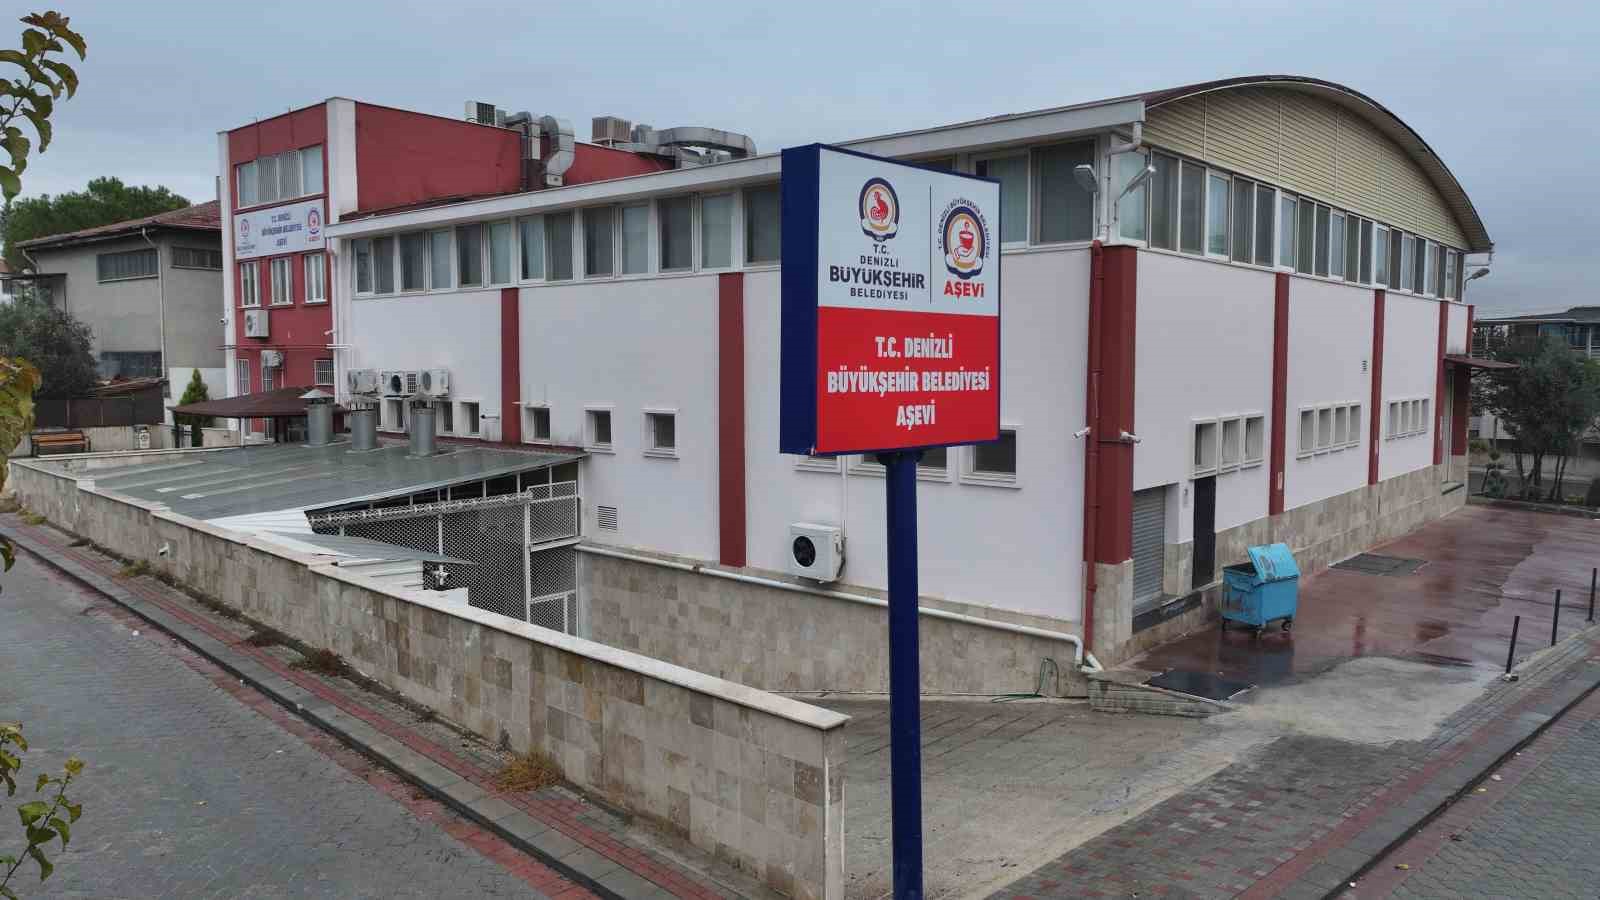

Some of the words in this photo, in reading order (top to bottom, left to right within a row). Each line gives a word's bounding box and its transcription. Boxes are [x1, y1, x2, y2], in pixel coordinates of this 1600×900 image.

[873, 243, 890, 255] T.C.
[875, 336, 901, 358] T.C.
[904, 332, 953, 359] DENİZLİ
[827, 364, 919, 397] BÜYÜKŞEHİR
[921, 365, 990, 392] BELEDİYESİ
[895, 399, 936, 431] AŞEVİ
